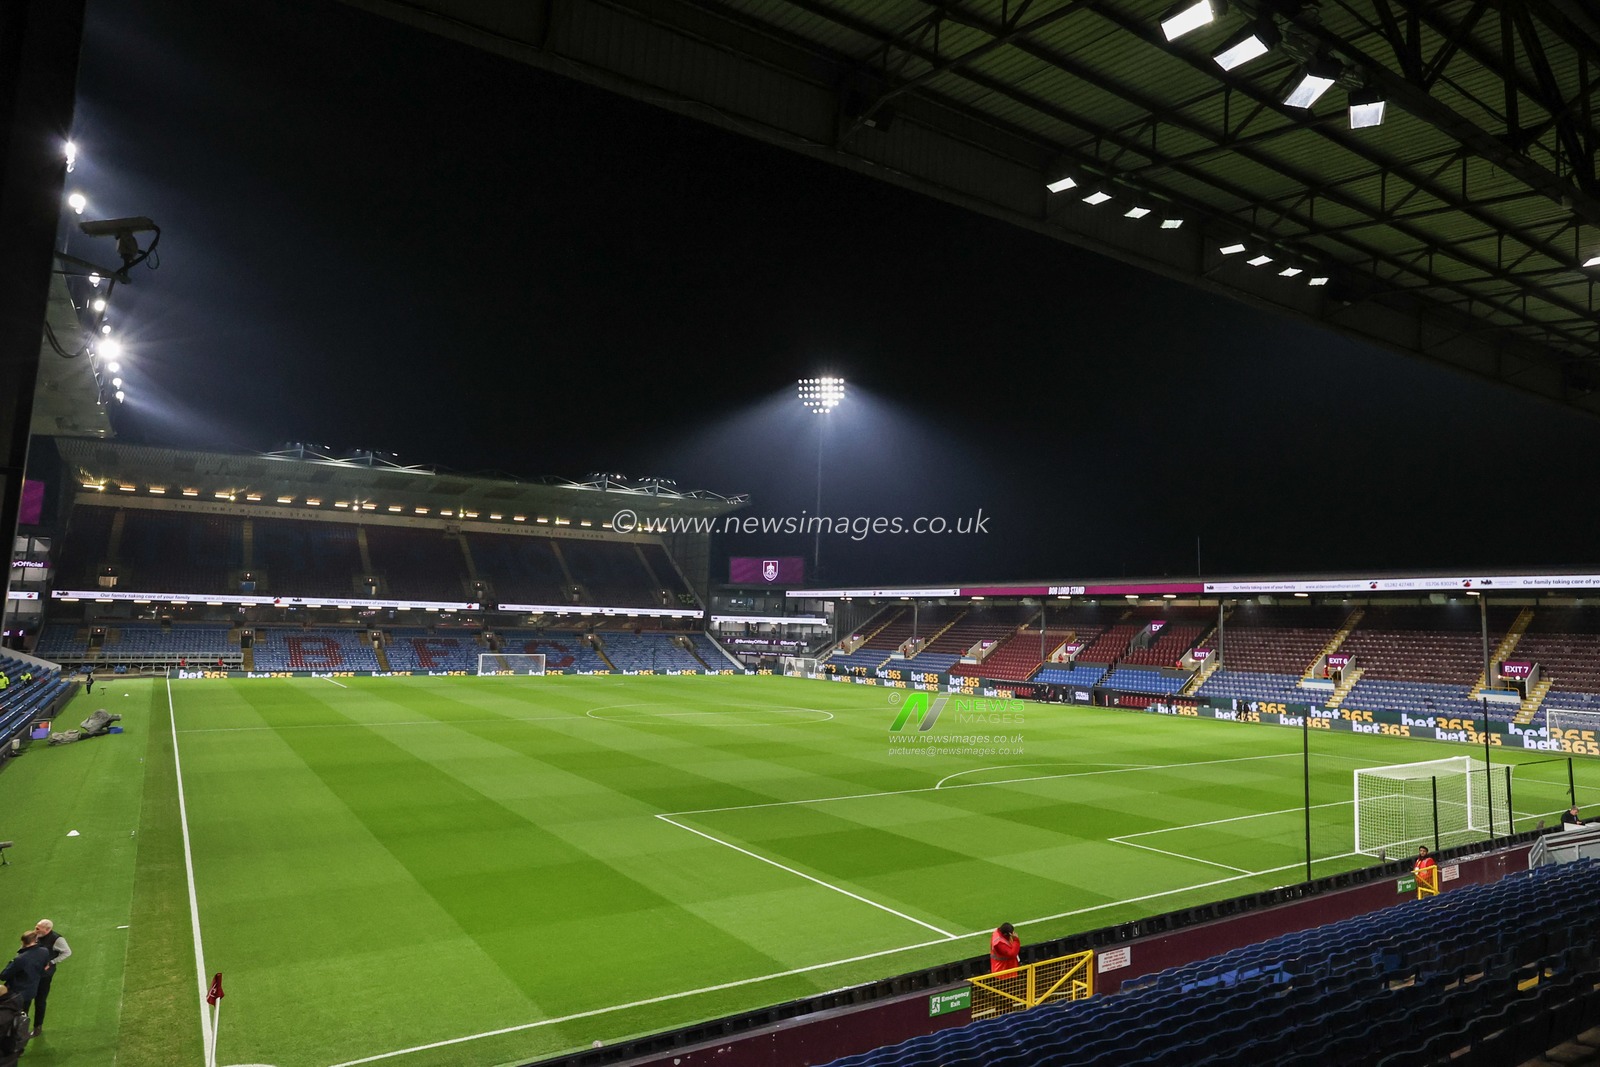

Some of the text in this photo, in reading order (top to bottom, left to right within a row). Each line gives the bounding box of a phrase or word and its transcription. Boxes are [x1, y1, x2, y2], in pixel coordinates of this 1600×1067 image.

[1048, 586, 1085, 595] BOB LORD STAND
[179, 669, 228, 679] bet365
[832, 674, 851, 683] bet365
[911, 672, 938, 683] bet365
[856, 677, 876, 685] bet365
[884, 680, 906, 688] bet365
[915, 682, 938, 691] bet365
[950, 675, 979, 687] bet365
[948, 685, 974, 695] bet365
[984, 688, 1012, 698] bet365
[1311, 706, 1374, 722] bet365
[1401, 713, 1475, 731] bet365
[1352, 720, 1410, 737] bet365
[1508, 723, 1595, 741] bet365
[1436, 727, 1502, 746] bet365
[1523, 735, 1600, 755] bet365
[941, 991, 969, 1002] Emergency
